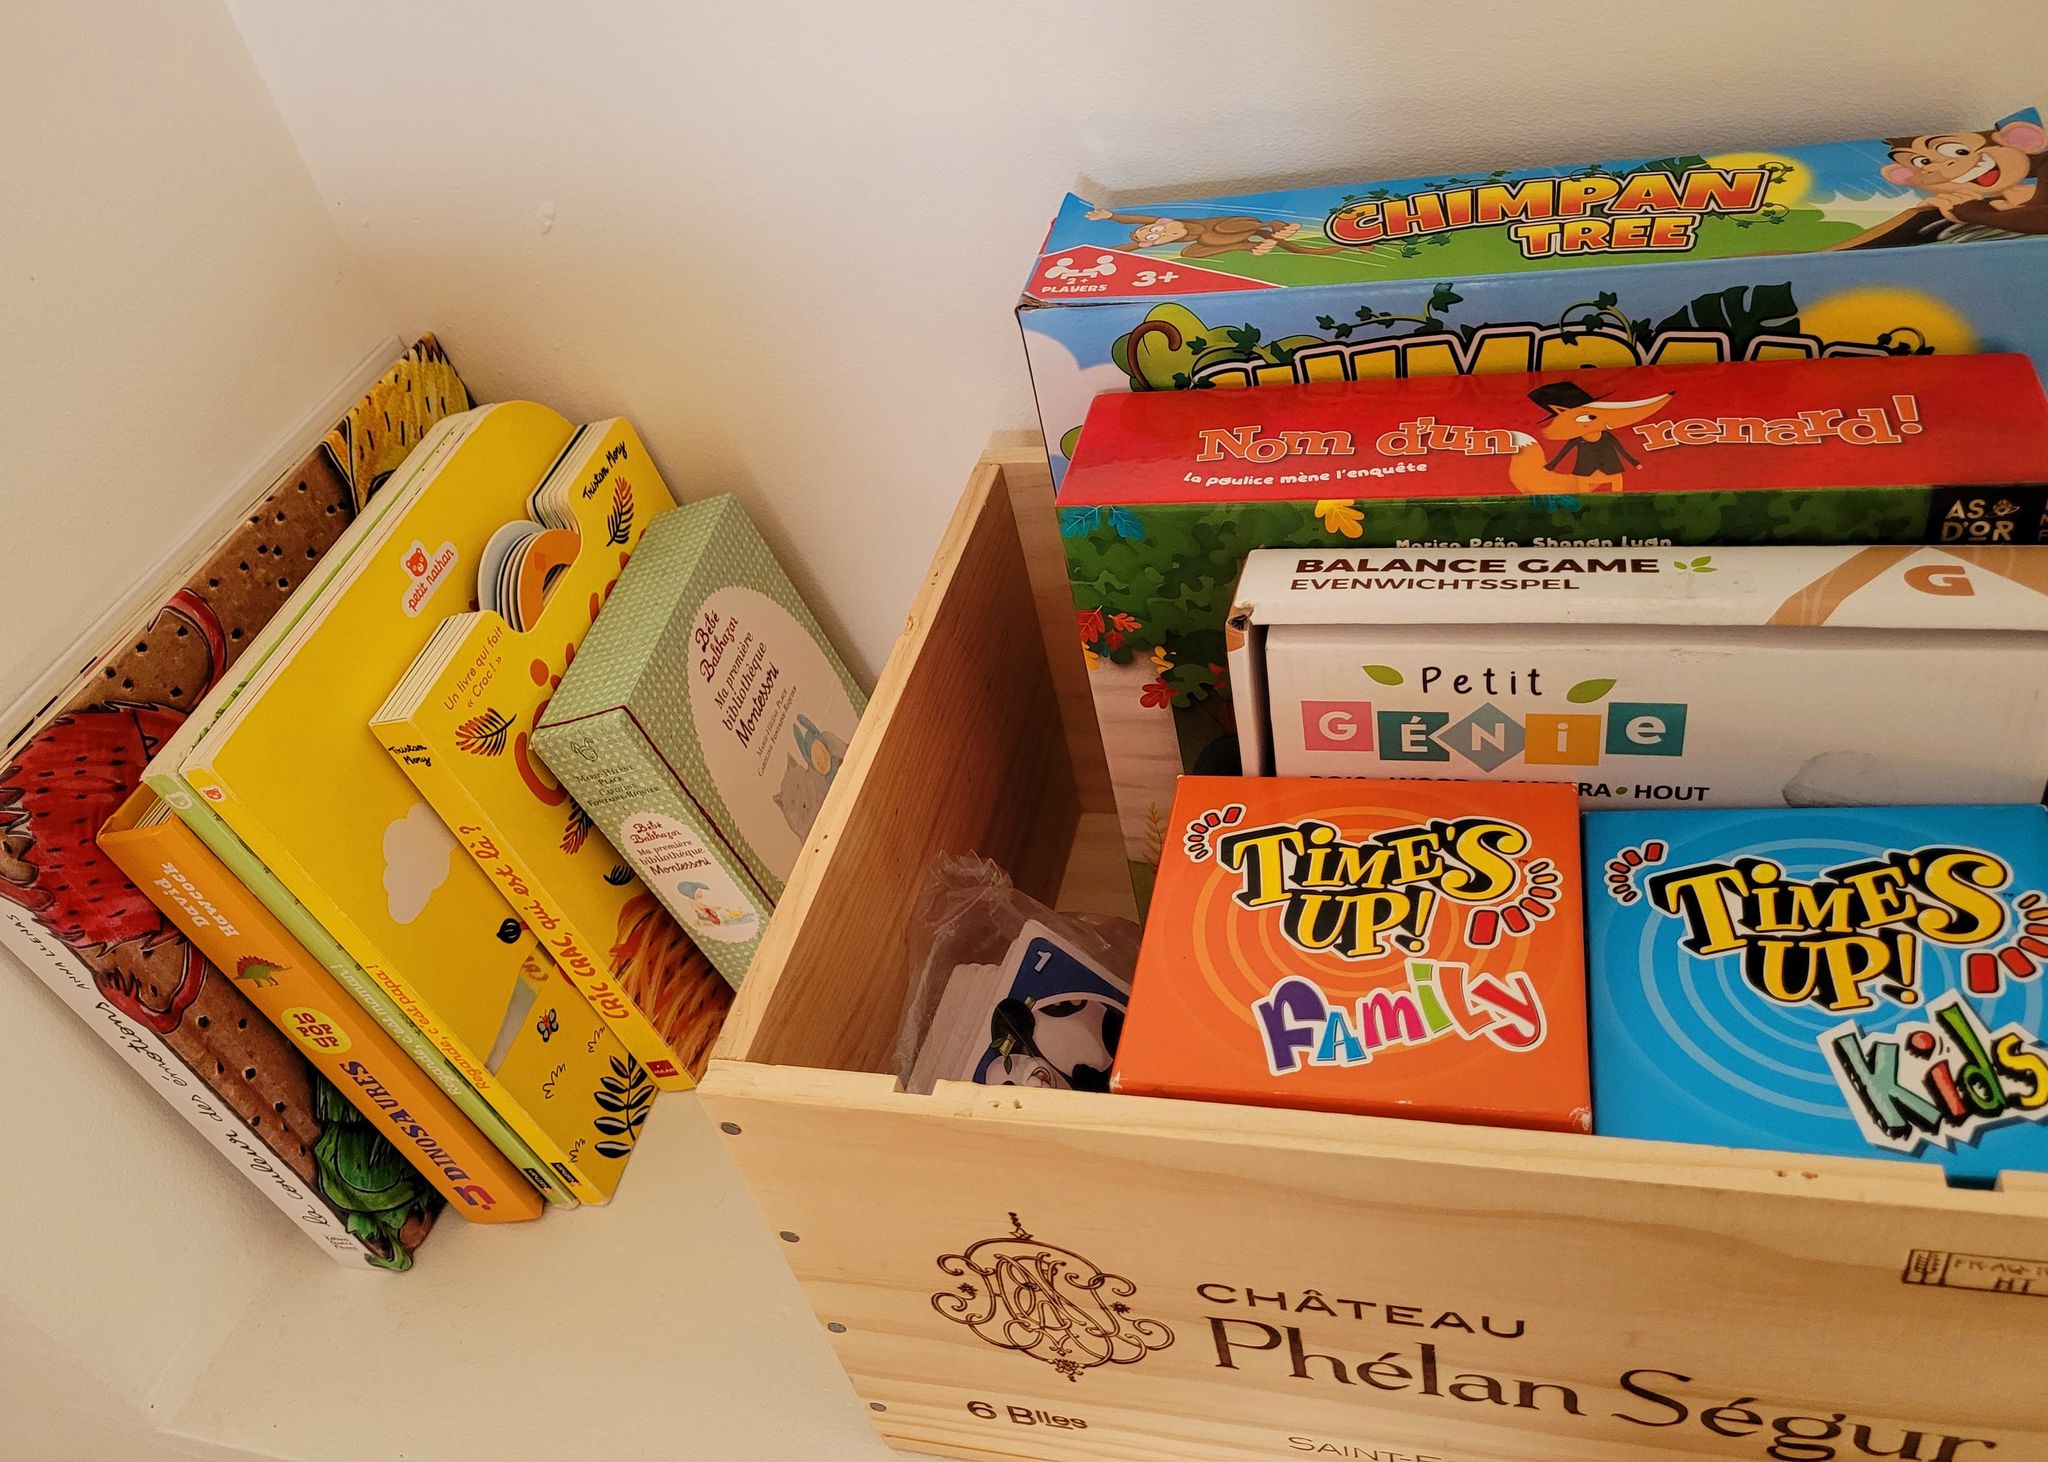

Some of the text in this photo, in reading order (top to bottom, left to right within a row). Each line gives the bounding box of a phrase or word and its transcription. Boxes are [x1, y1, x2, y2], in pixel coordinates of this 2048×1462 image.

[1327, 169, 1771, 248] CHIMPAN
[1514, 214, 1697, 257] TREE
[1041, 284, 1108, 293] PLAYERS
[1132, 271, 1179, 287] 3+
[1197, 394, 1923, 465] Nom d'un renard!
[582, 441, 628, 500] Tristan Mory
[1205, 476, 1274, 487] poulice
[1280, 472, 1331, 484] mène
[1337, 462, 1428, 480] l'enquête
[1945, 499, 1986, 519] AS
[1941, 520, 2014, 541] D'OR
[408, 548, 454, 612] petit nathan
[1296, 558, 1660, 573] BALANCE GAME
[1903, 564, 1975, 598] G
[1289, 577, 1580, 591] EVENWICHTSSPEL
[695, 608, 721, 653] Bébé
[699, 616, 739, 683] Balthazar
[443, 625, 503, 710] Un livre qui fait
[713, 630, 754, 711] Ma première
[1420, 667, 1544, 698] Petit
[722, 641, 768, 732] bibliothèque
[776, 687, 788, 710] PLACE
[735, 661, 780, 749] Montessori
[388, 744, 428, 755] Tristan
[403, 755, 432, 768] Mory
[1634, 784, 1711, 802] HOUT
[629, 829, 682, 844] Balthazar
[632, 820, 663, 834] Bébé
[469, 834, 500, 860] là
[636, 840, 694, 857] Ma première
[638, 847, 705, 866] bibliothèque
[495, 863, 530, 897] est
[649, 857, 712, 876] Montessori
[153, 877, 212, 928] David
[161, 862, 240, 938] Hawcock
[523, 898, 561, 931] qui
[5, 913, 56, 957] LLENAS
[1282, 887, 1435, 957] UP!
[54, 961, 92, 990] ANNA
[1033, 948, 1053, 973] 1
[1746, 929, 1918, 1012] UP!
[340, 968, 387, 1017] maman
[376, 969, 415, 1006] papa
[292, 1012, 317, 1025] 10
[296, 1023, 333, 1037] POP
[95, 1001, 188, 1087] émotions
[312, 1036, 340, 1049] UP
[1832, 1004, 2048, 1141] Kids
[191, 1094, 224, 1122] des
[339, 1061, 471, 1182] DINOSAURES
[225, 1129, 304, 1200] couleur
[1196, 1283, 1525, 1338] CHÂTEAU
[1204, 1315, 1997, 1462] Phélan Ségur
[967, 1400, 997, 1419] 6
